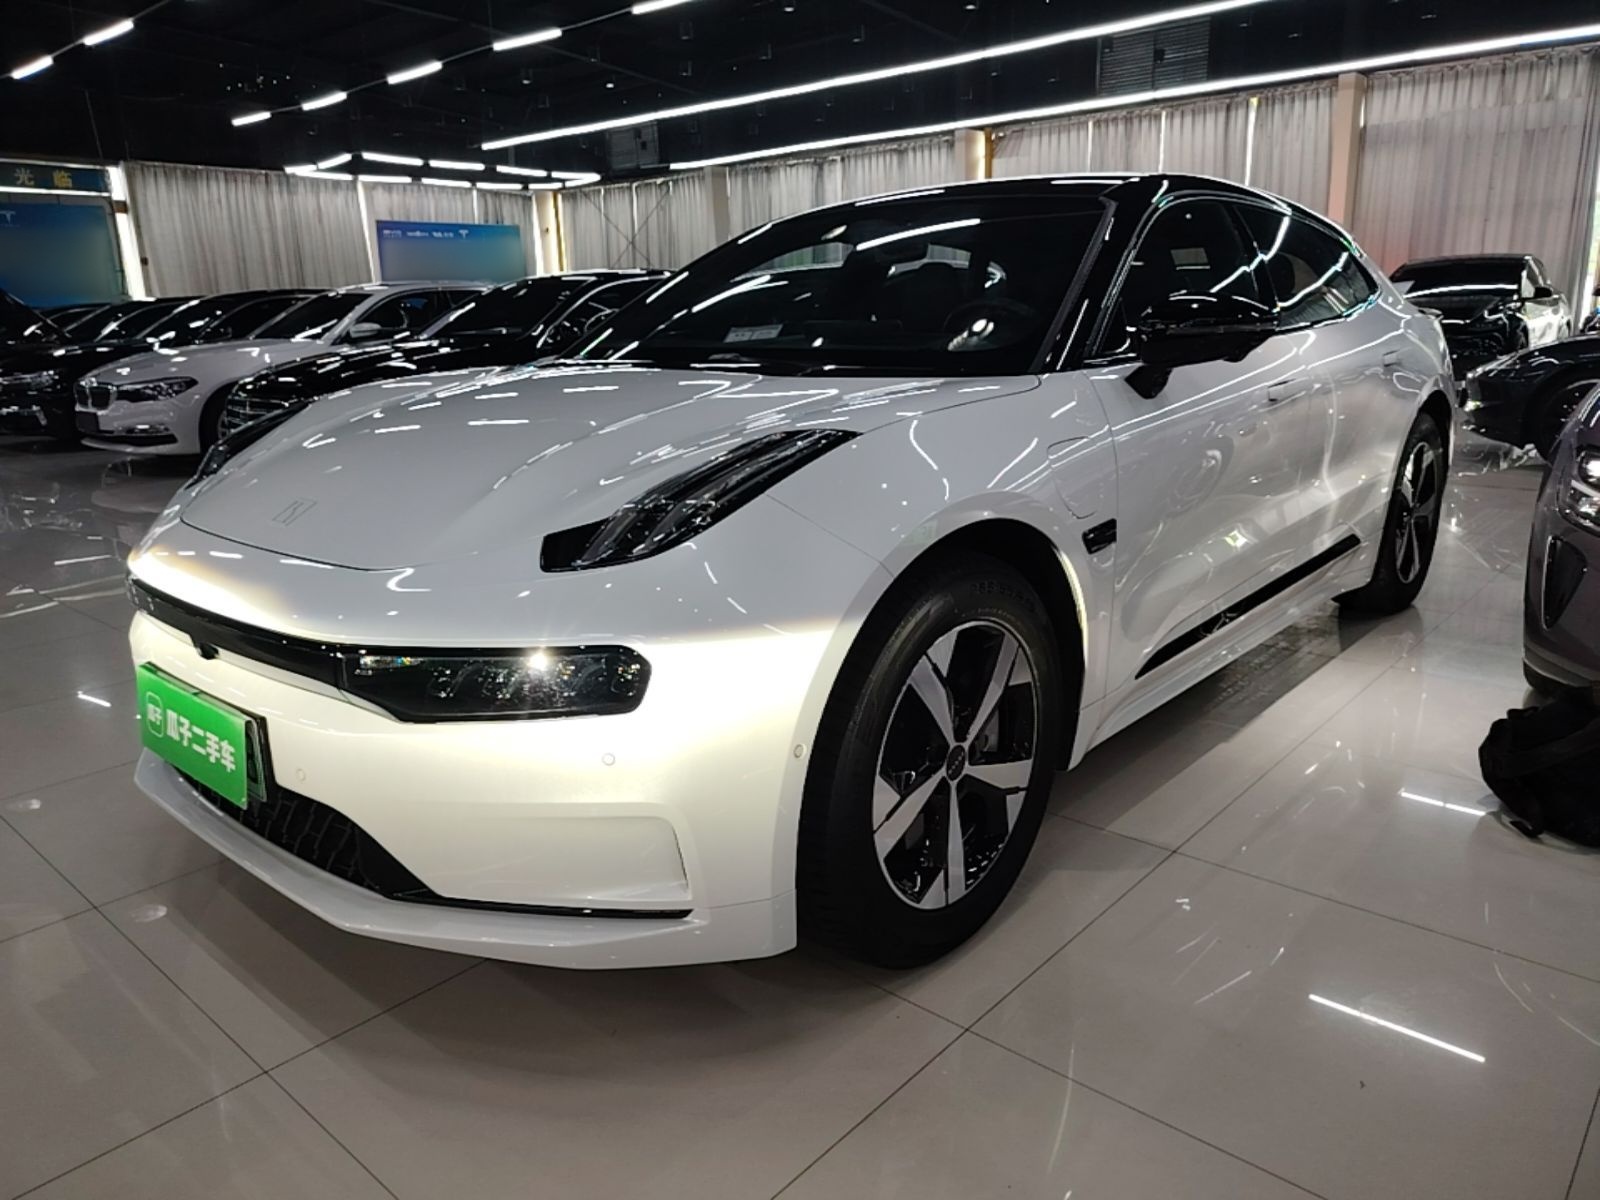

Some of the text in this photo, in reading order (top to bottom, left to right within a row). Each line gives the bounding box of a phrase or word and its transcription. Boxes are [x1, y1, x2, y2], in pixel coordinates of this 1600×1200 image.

[15, 167, 73, 188] 光临
[166, 709, 236, 773] 瓜子二手车
